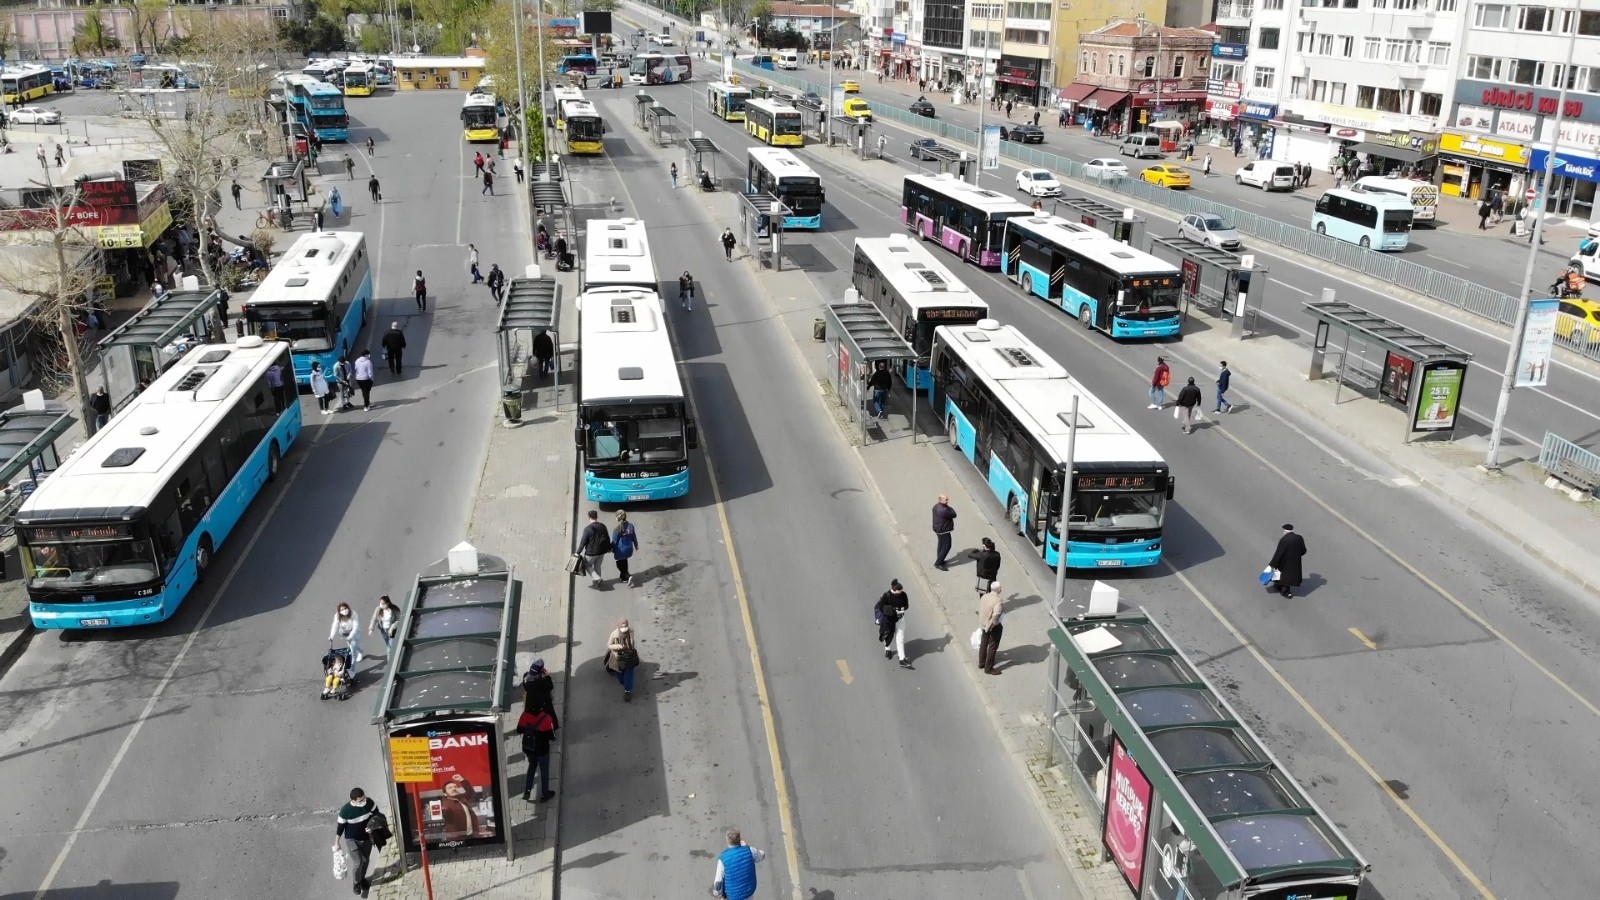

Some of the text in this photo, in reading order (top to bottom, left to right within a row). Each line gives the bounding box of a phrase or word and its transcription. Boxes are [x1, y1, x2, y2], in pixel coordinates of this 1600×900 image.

[1482, 87, 1583, 118] SÜRÜCÜ KUSU
[1247, 104, 1270, 117] METRO
[84, 182, 127, 193] BALIK
[77, 211, 99, 220] BÜFE
[1430, 387, 1450, 395] 25 TL
[429, 735, 489, 749] BANK
[1115, 768, 1144, 822] MUTLULUK
